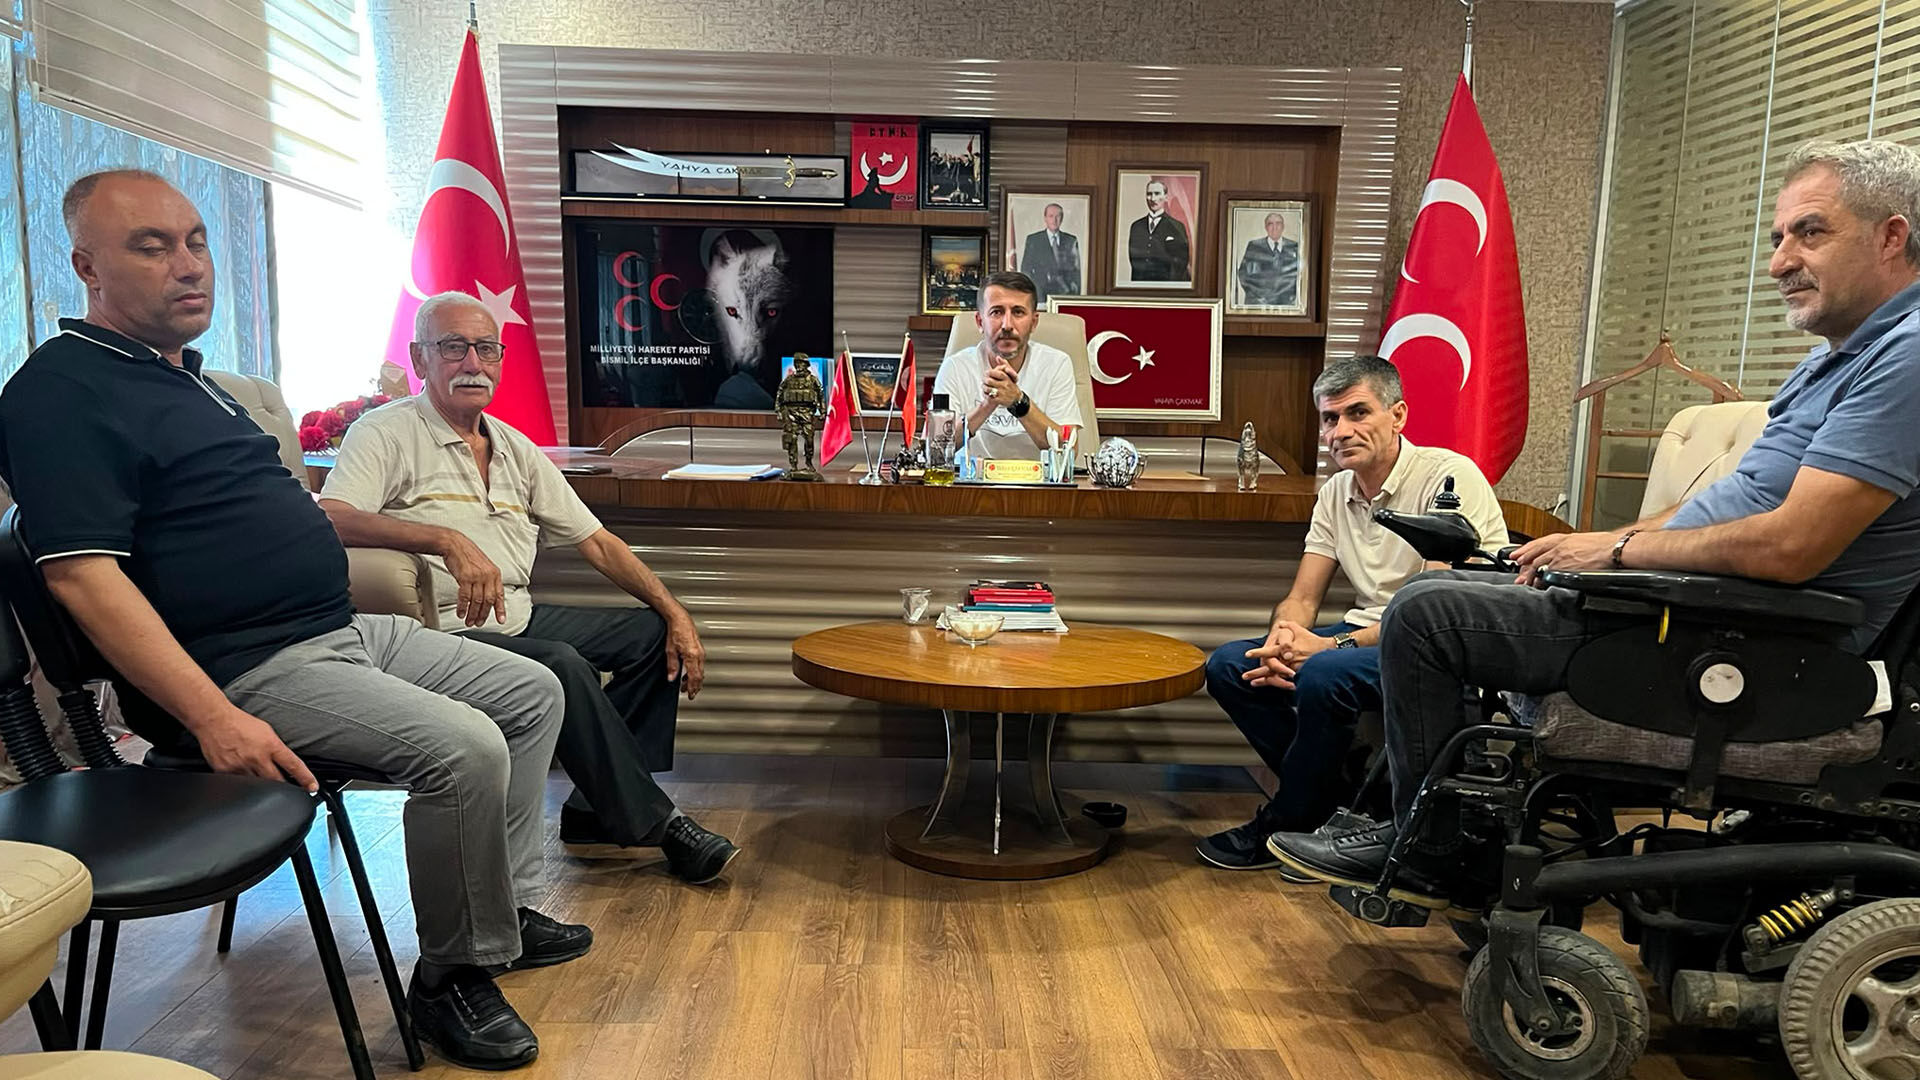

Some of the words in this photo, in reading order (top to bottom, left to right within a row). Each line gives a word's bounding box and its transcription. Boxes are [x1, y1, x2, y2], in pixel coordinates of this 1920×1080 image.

[661, 161, 711, 174] YAHYA
[590, 344, 636, 354] MİLLİYETÇİ
[638, 345, 677, 354] HAREKET
[678, 345, 711, 354] PARTİSİ
[601, 355, 629, 364] BİSMİL
[630, 355, 649, 365] İLÇE
[651, 356, 701, 366] BAŞKANLIĞI
